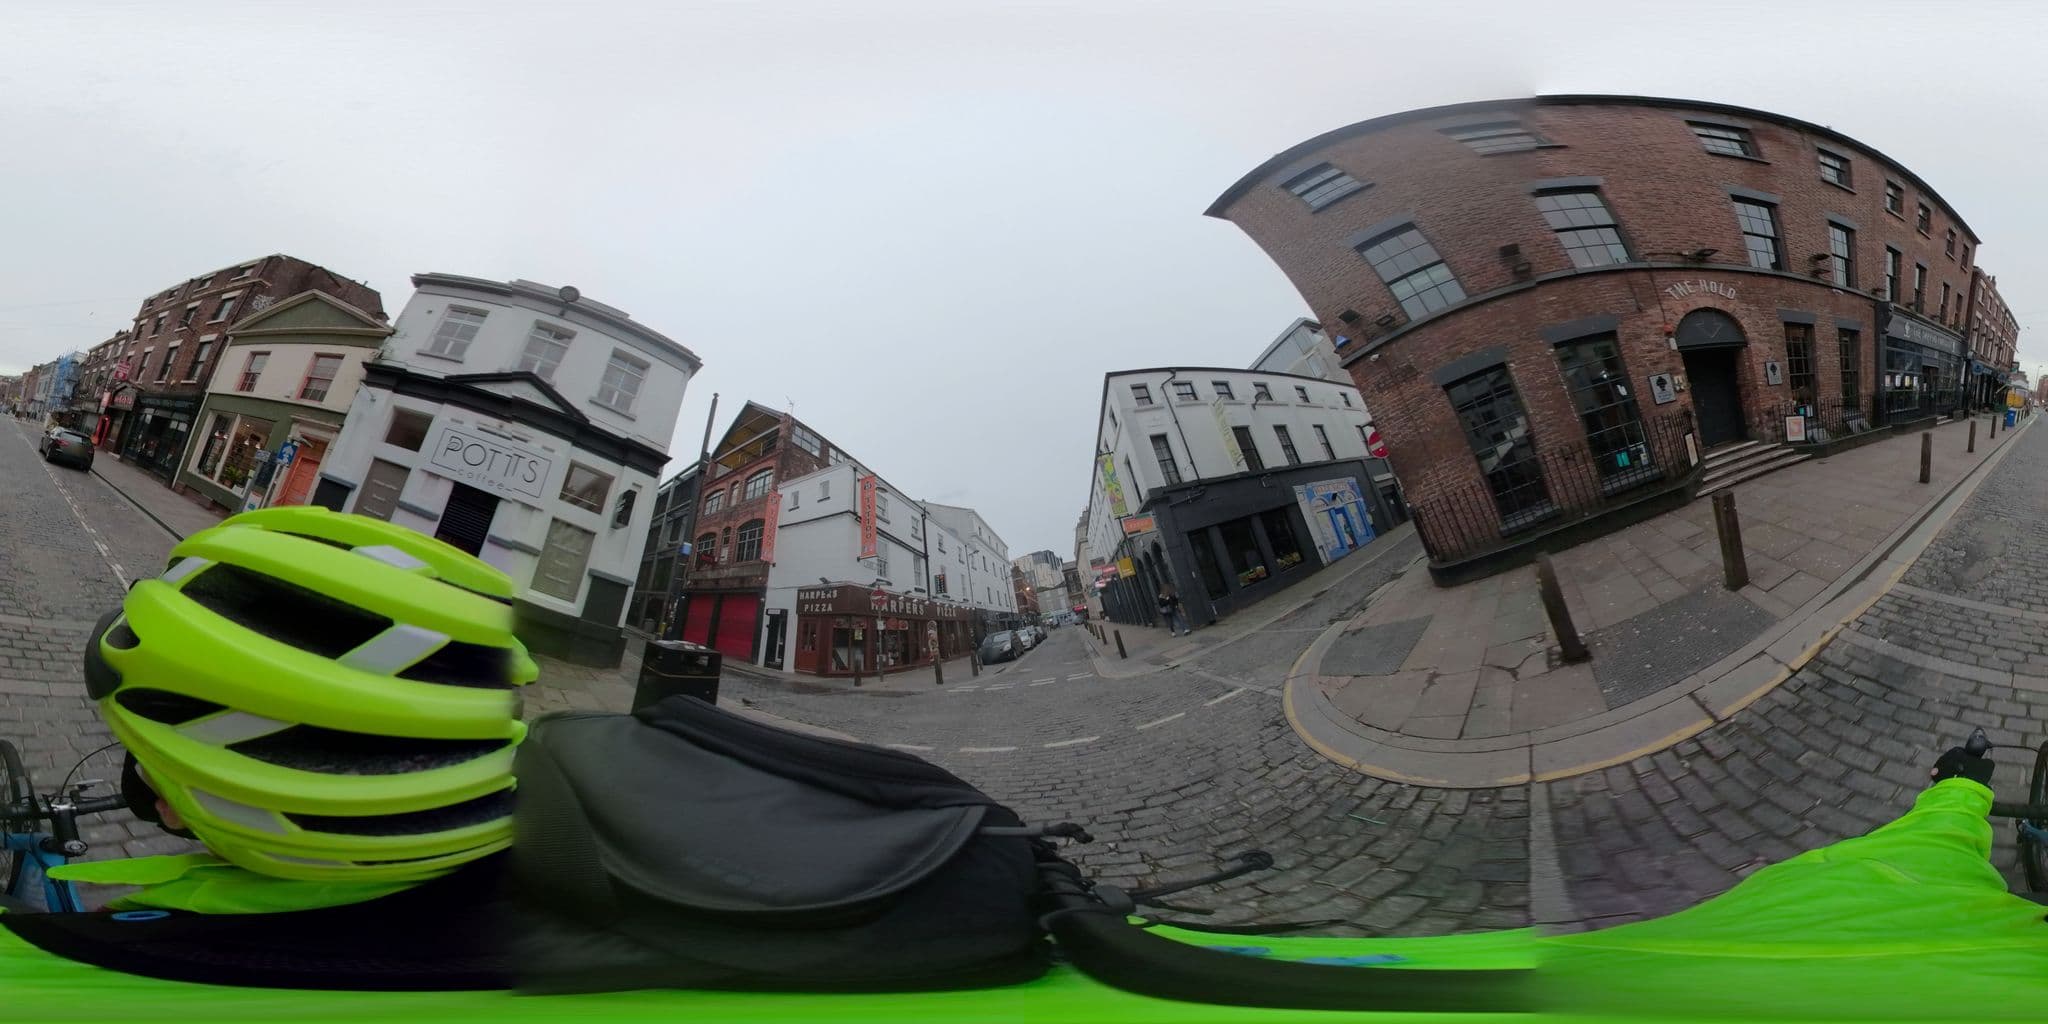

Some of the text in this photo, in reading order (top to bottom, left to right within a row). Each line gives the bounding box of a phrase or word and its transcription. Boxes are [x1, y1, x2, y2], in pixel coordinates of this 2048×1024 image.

[1664, 280, 1736, 300] THE HOLD
[458, 468, 505, 490] coffee
[800, 590, 838, 600] HARPERS
[804, 603, 833, 612] PIZZA
[870, 599, 956, 617] HARPERS PIZZA
